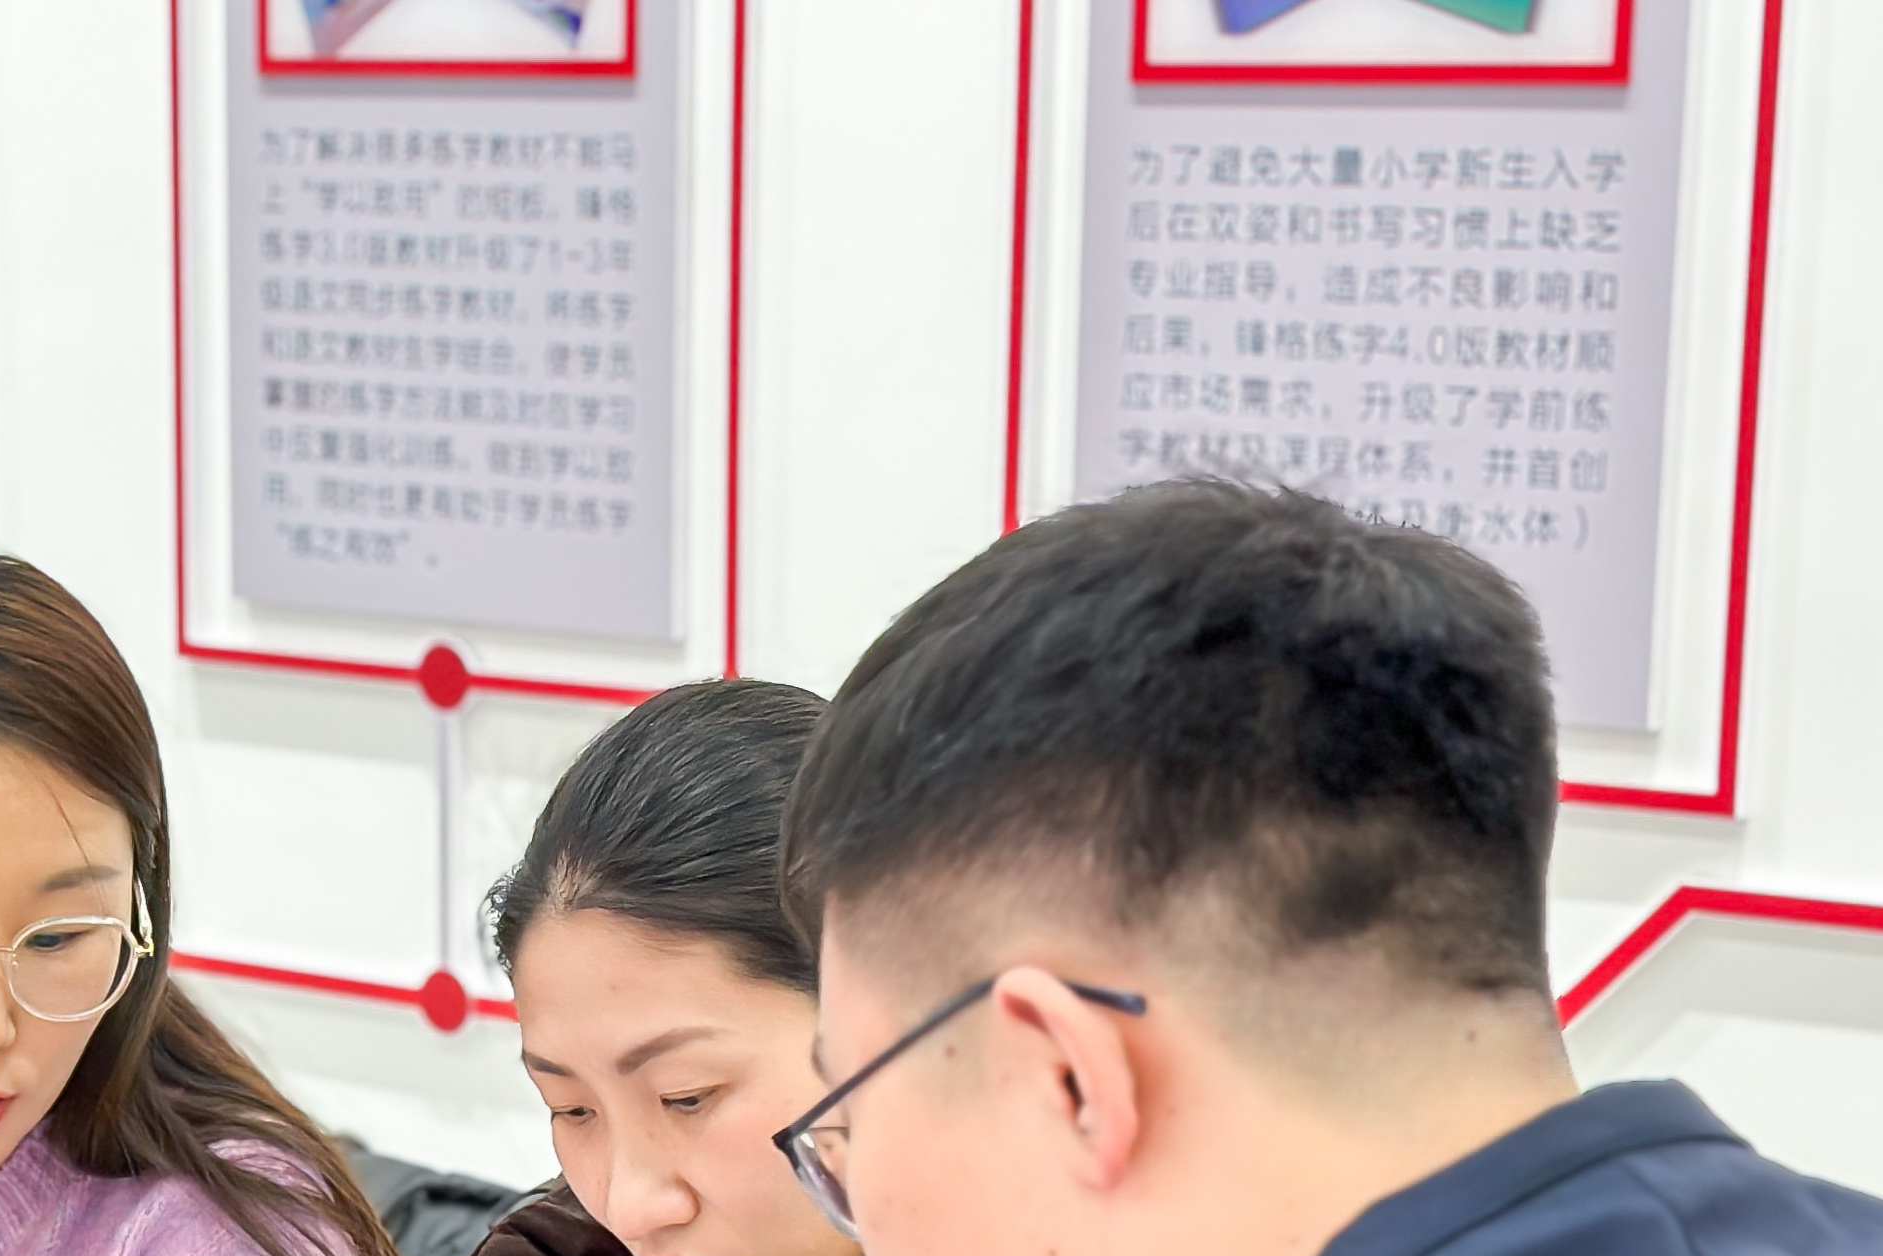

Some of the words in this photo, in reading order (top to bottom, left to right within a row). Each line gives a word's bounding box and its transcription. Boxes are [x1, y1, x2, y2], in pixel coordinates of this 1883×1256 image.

[1127, 145, 1625, 192] 为了避免大量小学新生入学
